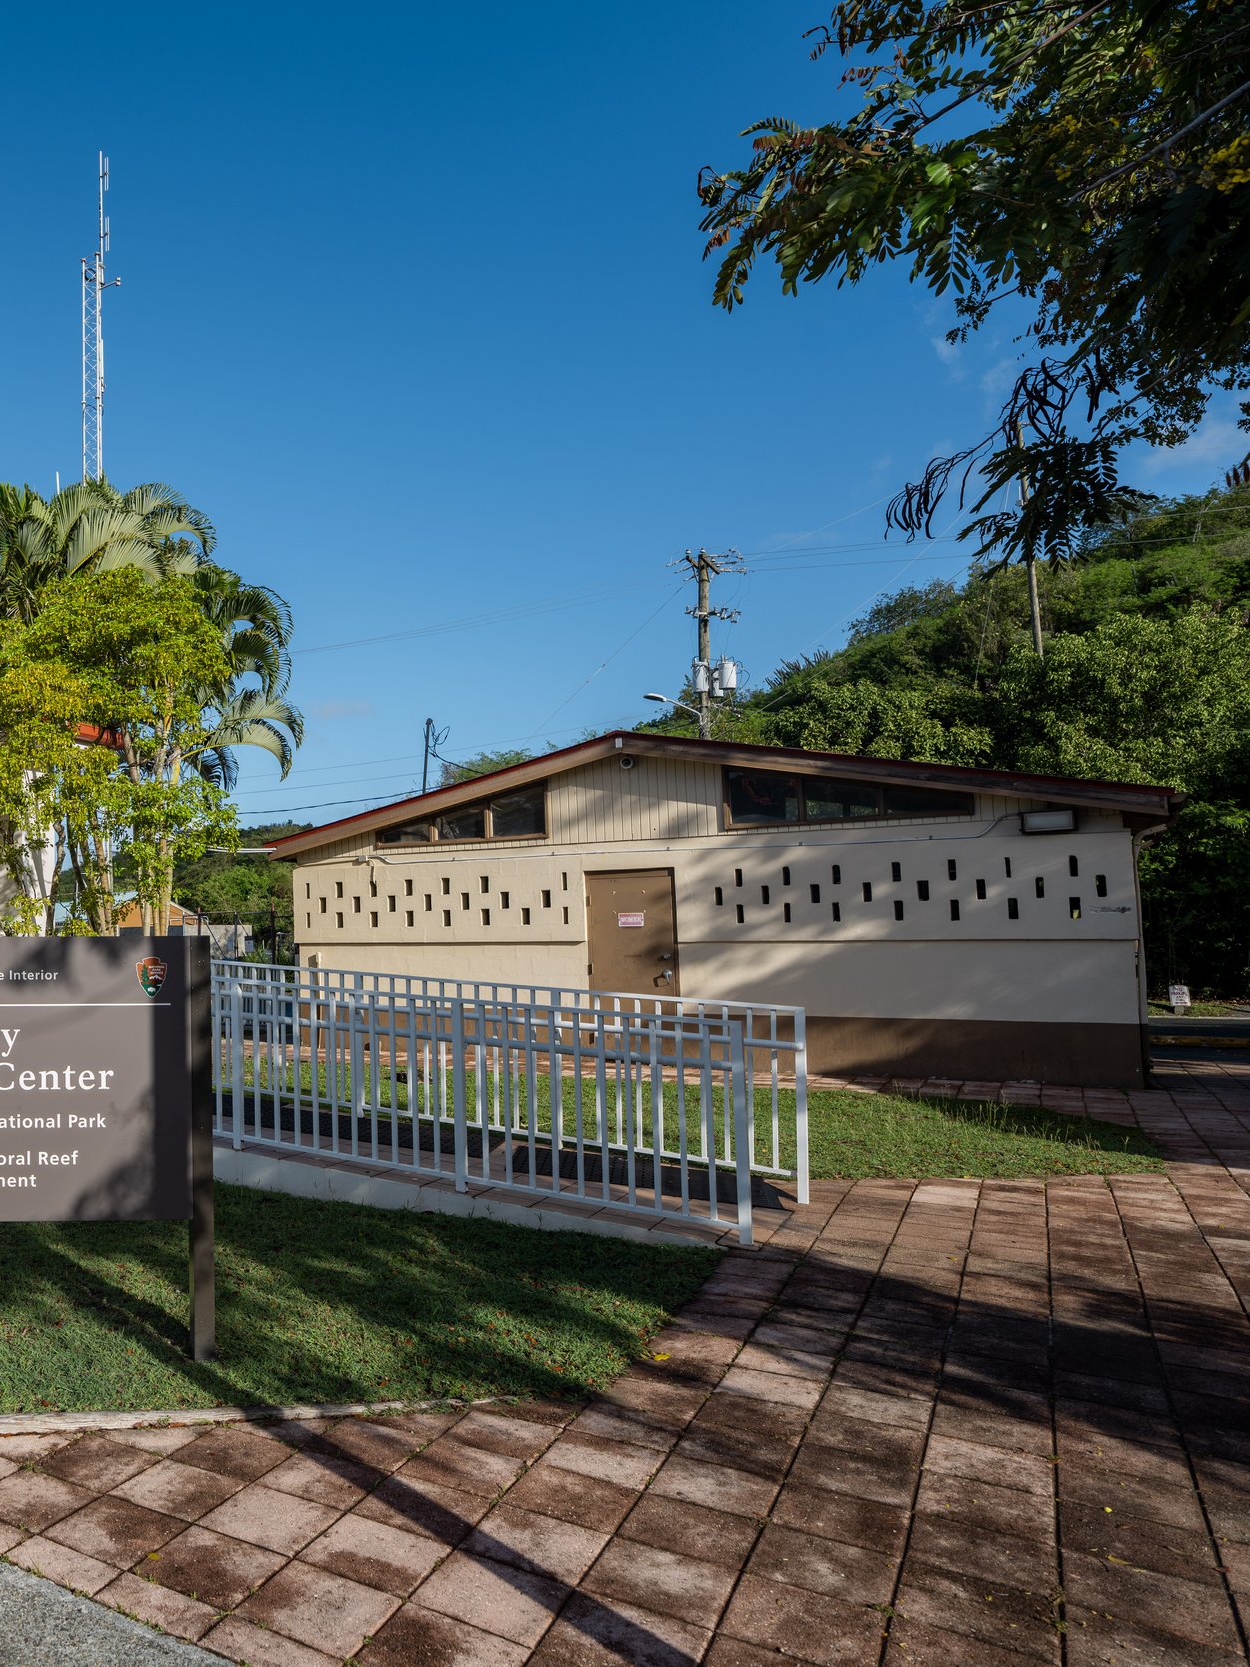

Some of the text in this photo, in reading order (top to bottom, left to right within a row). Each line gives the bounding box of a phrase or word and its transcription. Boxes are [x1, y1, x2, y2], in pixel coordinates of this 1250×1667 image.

[9, 969, 59, 981] Interior
[68, 1112, 107, 1129] Park
[38, 1150, 79, 1166] Reef
